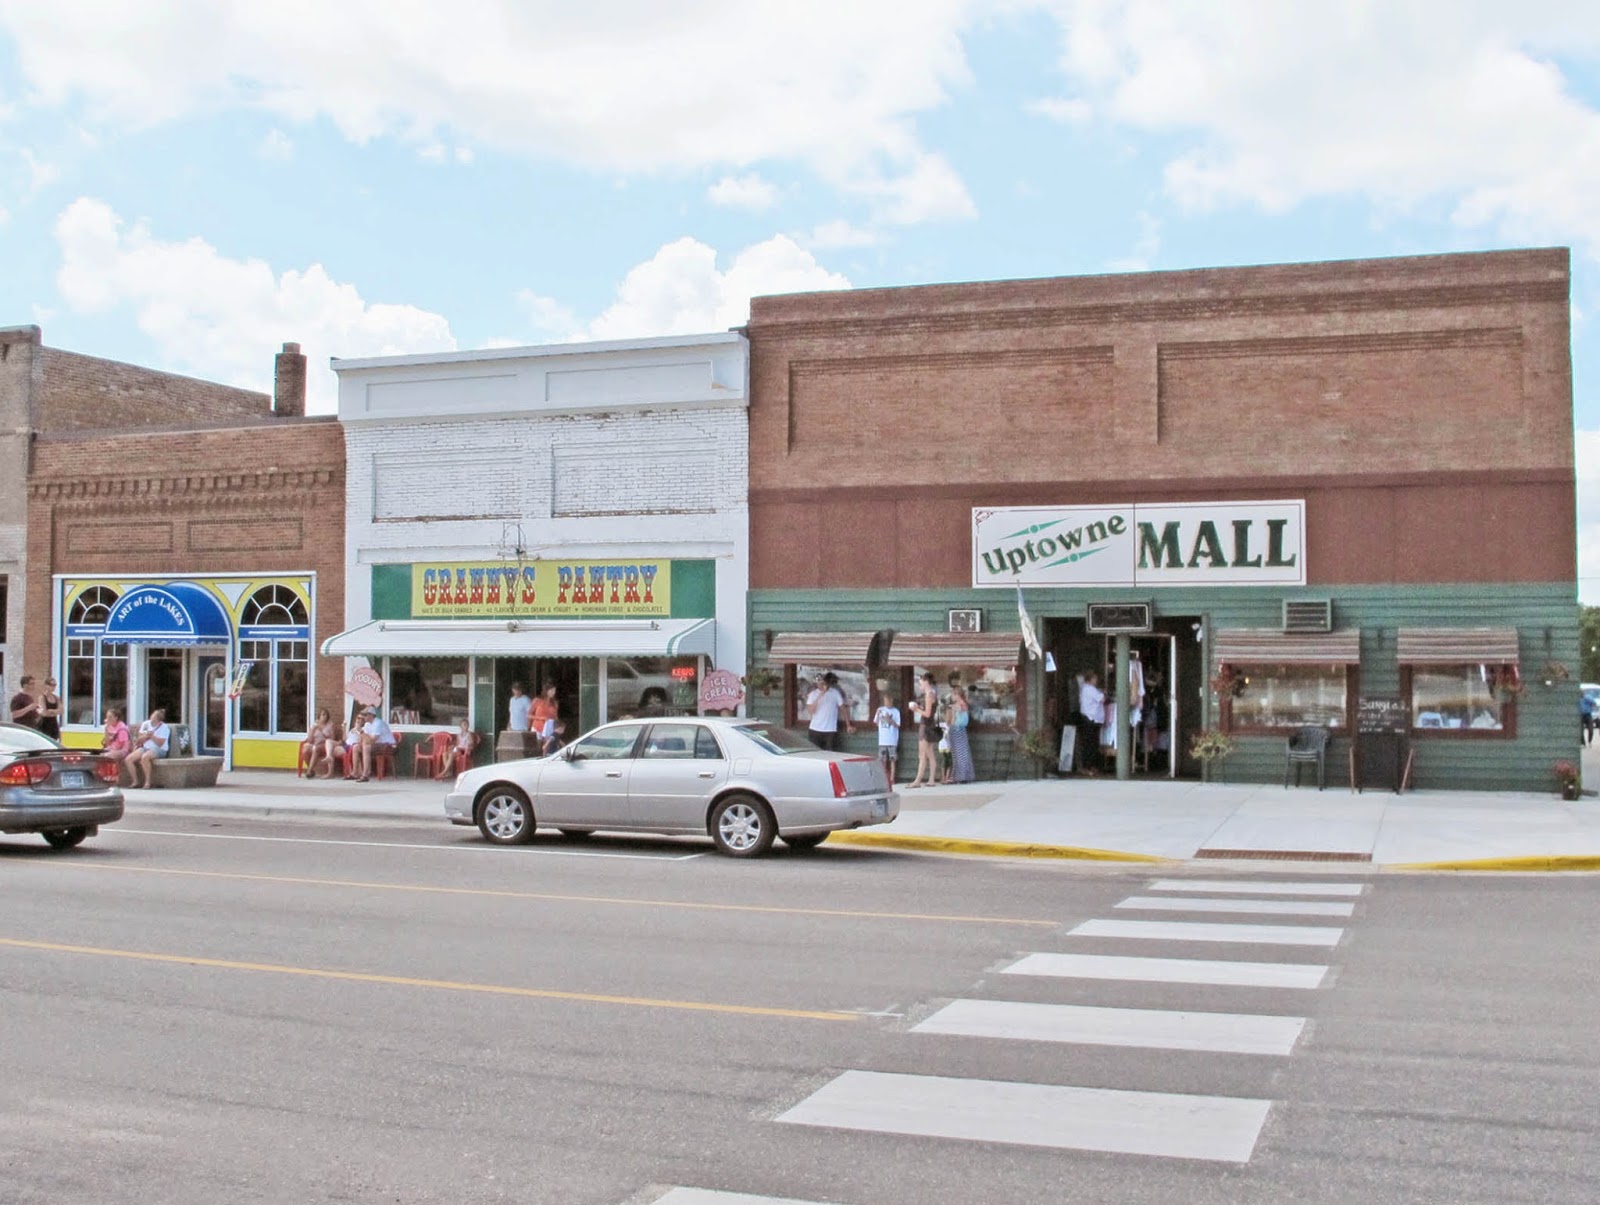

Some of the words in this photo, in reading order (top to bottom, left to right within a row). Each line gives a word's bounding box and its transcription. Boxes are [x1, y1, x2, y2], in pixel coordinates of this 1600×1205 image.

[981, 515, 1127, 576] Uptowne
[1137, 518, 1297, 568] MALL
[557, 565, 658, 604] PANTRY
[118, 601, 133, 623] ART
[133, 596, 143, 607] of
[144, 595, 158, 605] the
[159, 597, 186, 626] LAKES
[353, 673, 382, 692] YOGURT
[704, 687, 737, 702] CREAM
[710, 677, 727, 687] ICE
